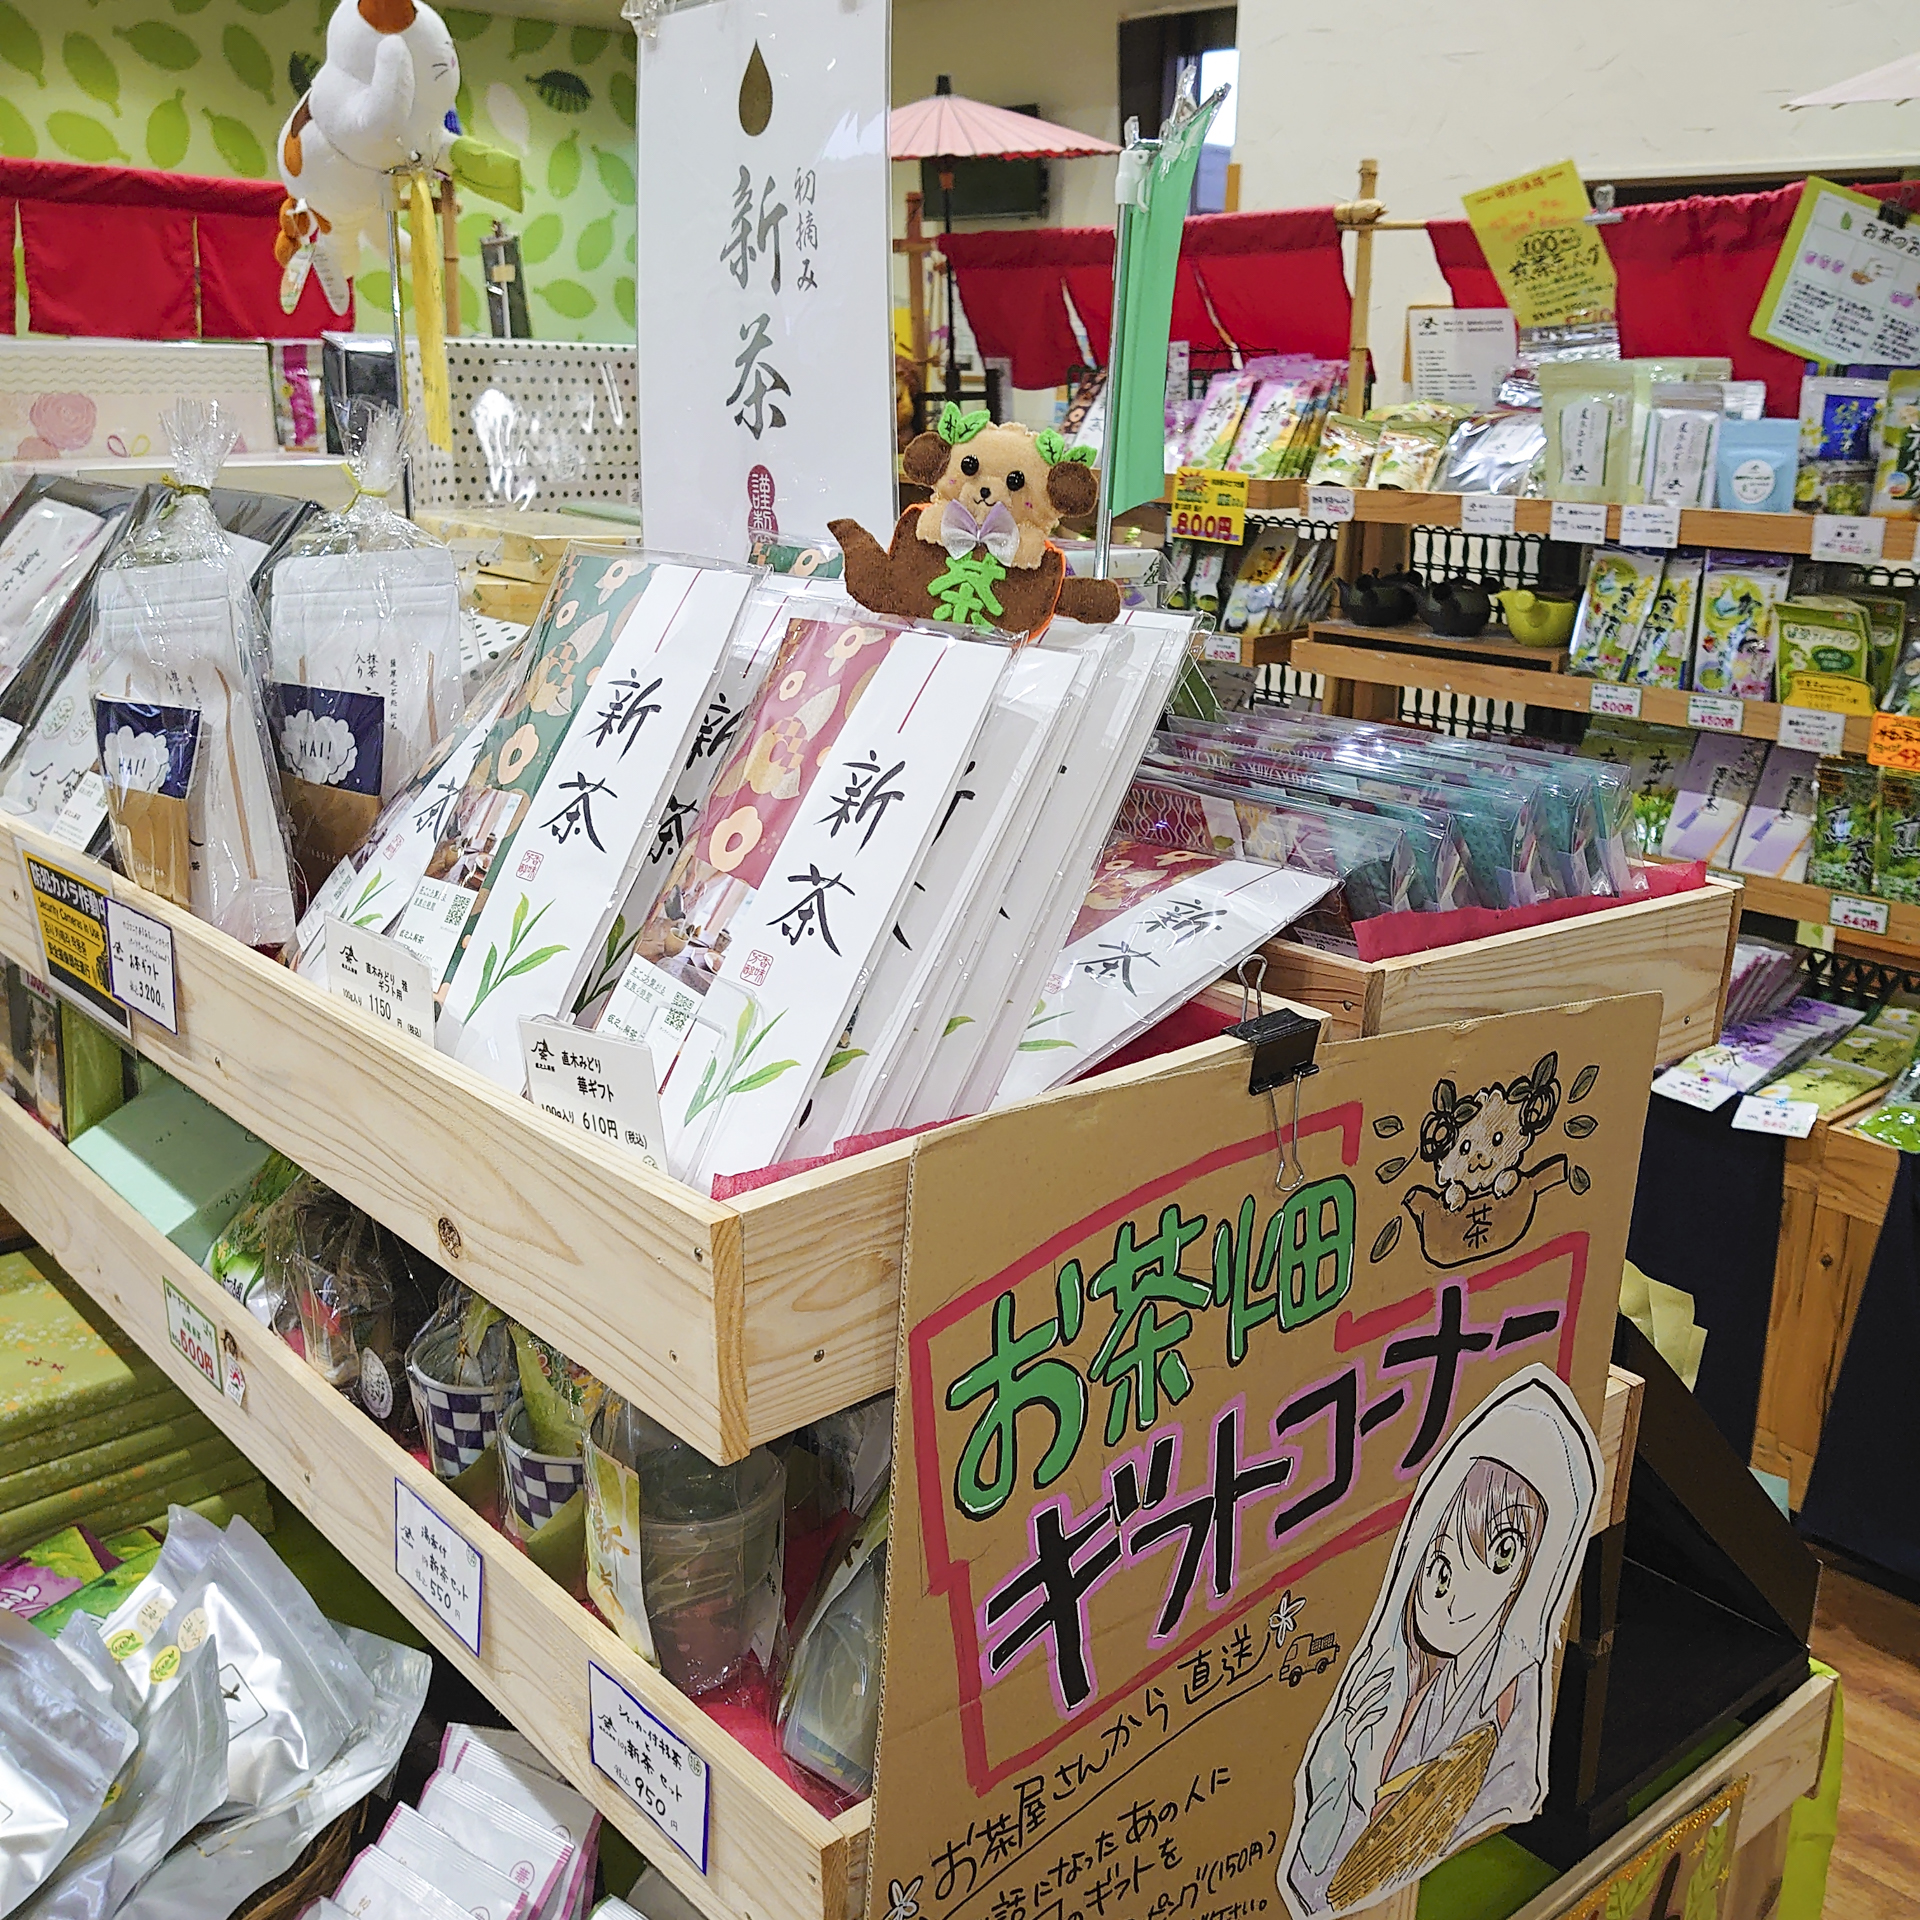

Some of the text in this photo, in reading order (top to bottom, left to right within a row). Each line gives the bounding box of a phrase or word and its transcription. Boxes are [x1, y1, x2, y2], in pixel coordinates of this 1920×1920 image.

[794, 167, 818, 292] 初摘み
[720, 164, 791, 440] 新茶
[1176, 512, 1233, 542] 800円
[927, 551, 1006, 635] 茶
[355, 653, 366, 679] 入り
[367, 652, 379, 678] 抹茶
[118, 758, 147, 778] HAI!
[299, 739, 332, 761] HAI!
[539, 668, 663, 853] 新茶
[648, 692, 750, 864] 新茶
[766, 750, 906, 957] 新茶
[29, 861, 105, 919] 防犯カメラ作動中
[1070, 898, 1228, 998] 新茶
[369, 993, 392, 1021] 1150
[378, 981, 403, 1002] ギフト用
[561, 1050, 602, 1074] 直木みどり
[577, 1076, 614, 1102] 華ギフト
[582, 1111, 619, 1139] 610円
[625, 1129, 648, 1150] (税込)
[1463, 1203, 1493, 1249] 茶
[946, 1173, 1357, 1520] お茶畑
[981, 1281, 1563, 1714] ギフトコーナー
[430, 1578, 451, 1609] 550
[635, 1776, 666, 1817] 950
[671, 1820, 678, 1832] 円
